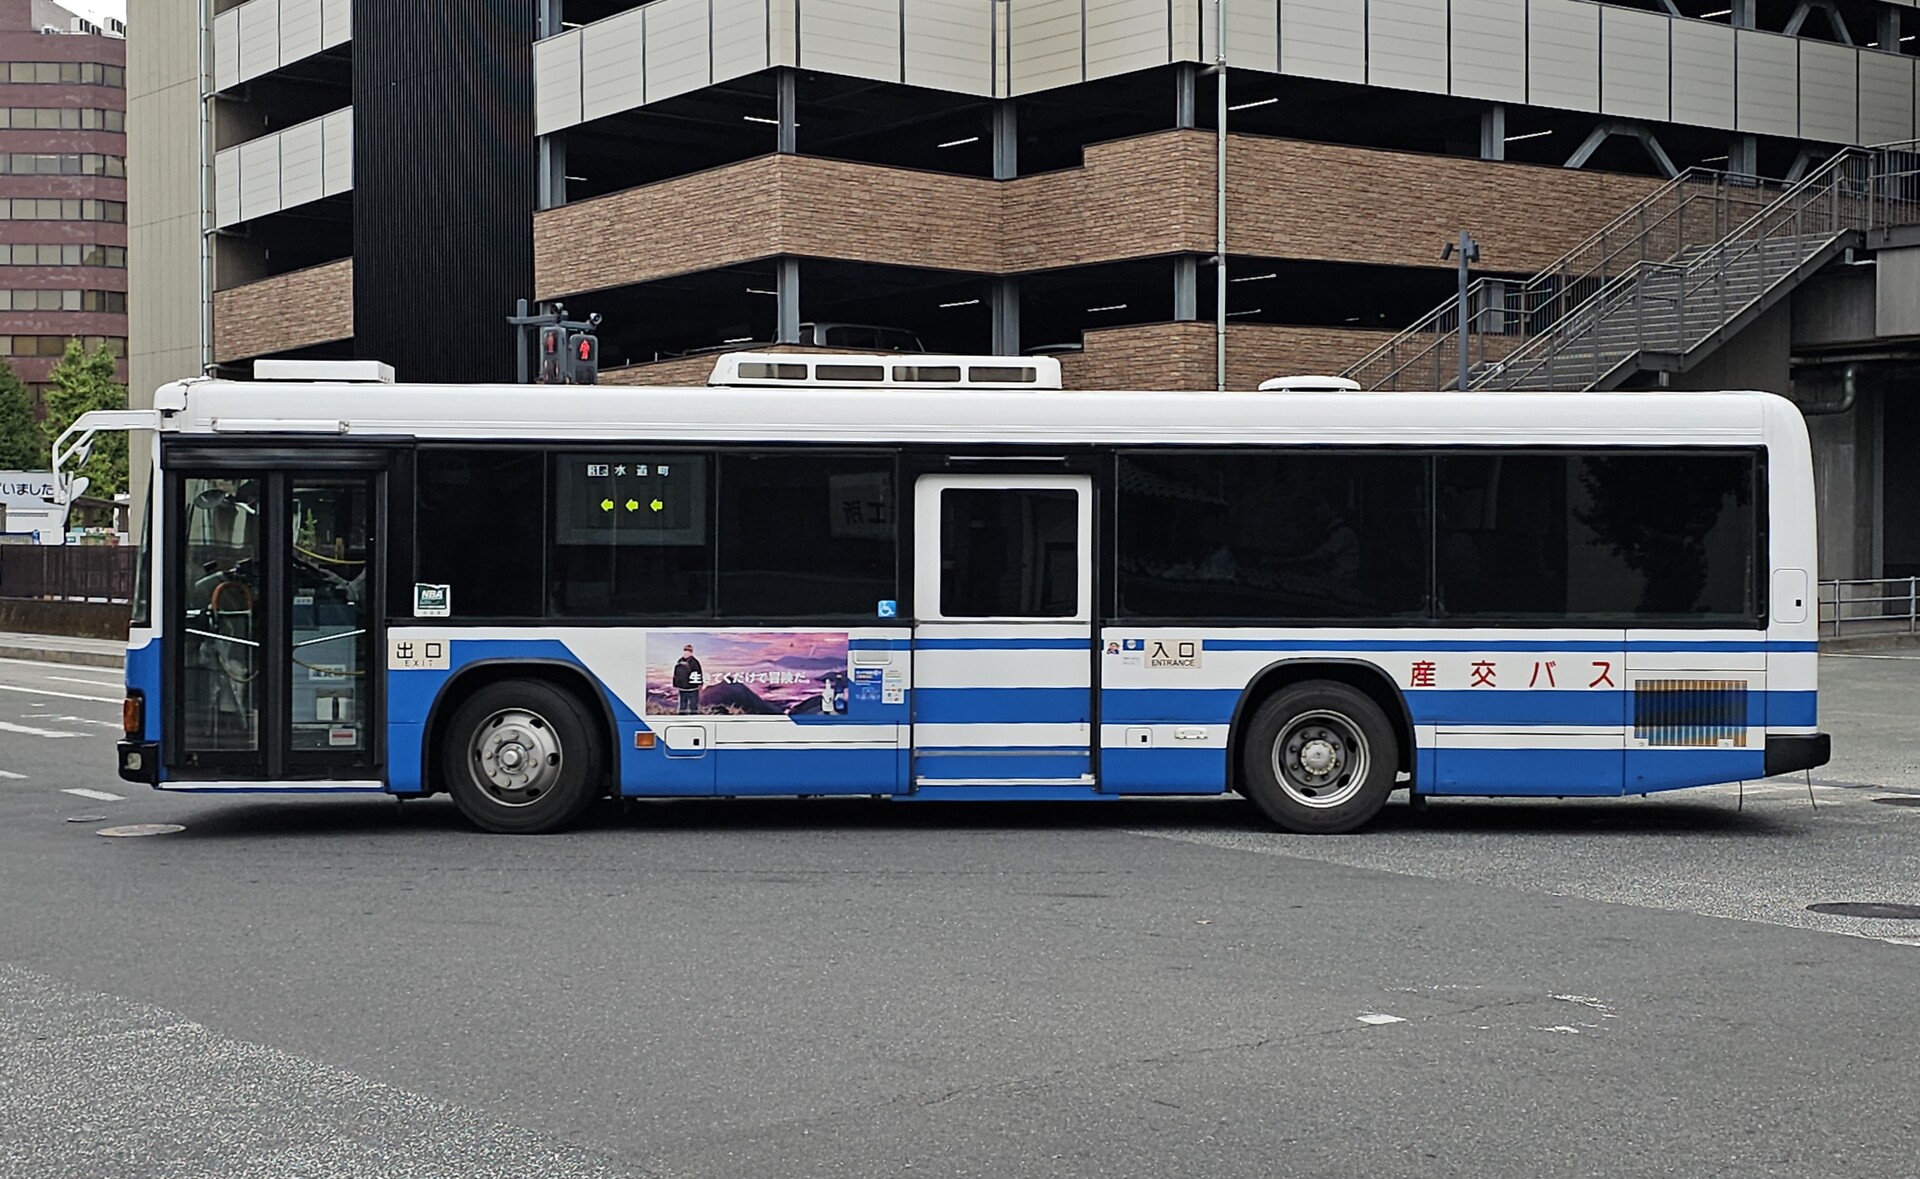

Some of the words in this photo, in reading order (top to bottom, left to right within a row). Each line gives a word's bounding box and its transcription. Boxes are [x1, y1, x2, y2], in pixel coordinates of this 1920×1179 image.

[0, 483, 54, 496] いました
[421, 589, 444, 600] NBA
[397, 642, 442, 659] 出口
[1152, 642, 1195, 658] 入口
[404, 659, 434, 667] EXIT
[1151, 659, 1195, 667] ENTRANCE
[1410, 660, 1615, 688] 産交バス
